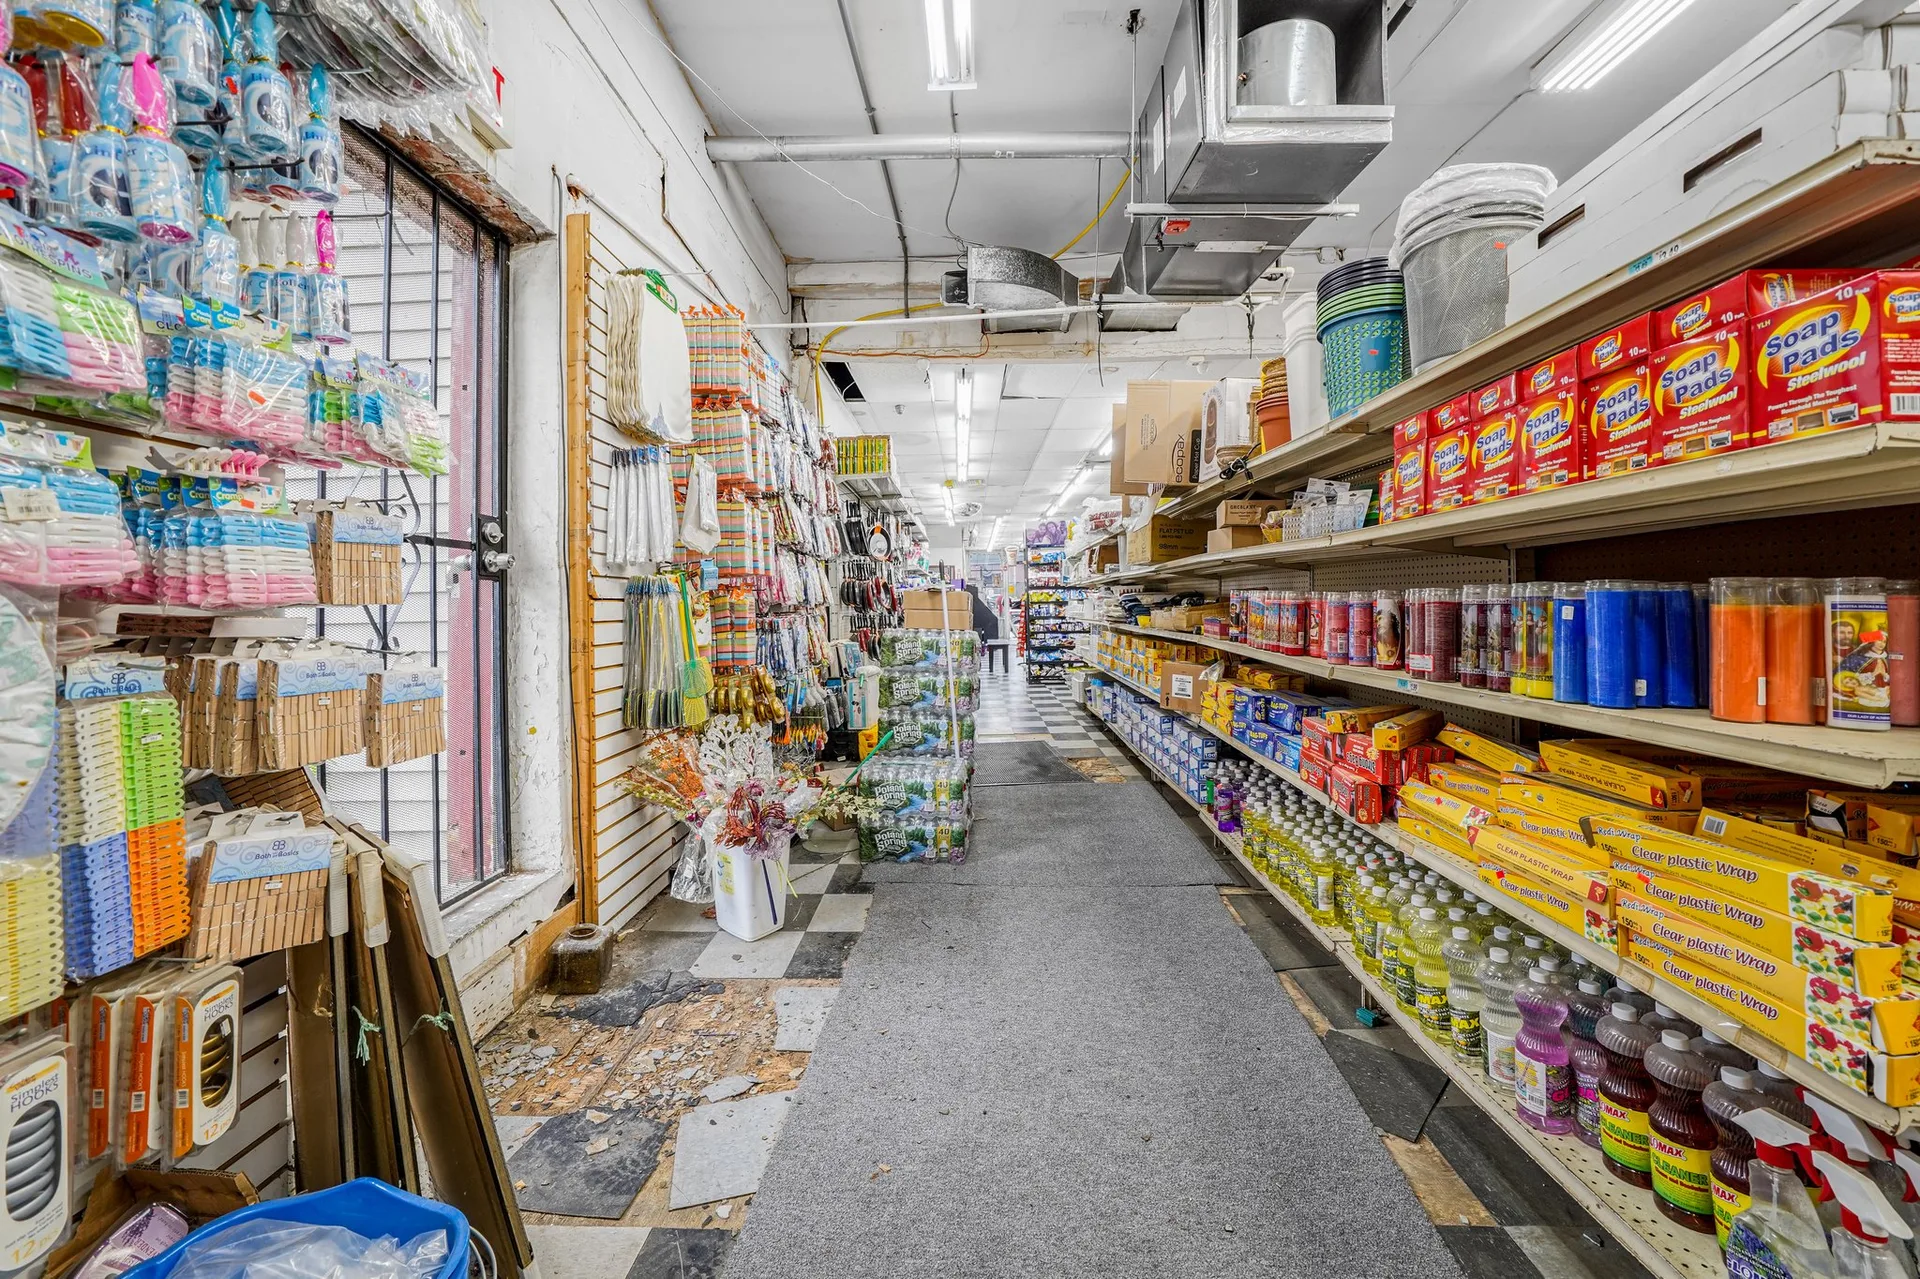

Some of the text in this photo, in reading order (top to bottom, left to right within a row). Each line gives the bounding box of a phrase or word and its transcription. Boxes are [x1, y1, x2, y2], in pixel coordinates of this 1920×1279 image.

[1834, 286, 1853, 301] 10
[216, 313, 246, 330] Cramp
[1674, 302, 1703, 325] Soap
[1681, 310, 1709, 332] Pads
[1719, 311, 1733, 324] 10
[1682, 319, 1713, 341] Steelwool
[1756, 318, 1771, 330] YLH
[1713, 329, 1727, 343] 10
[1765, 310, 1841, 358] Soap
[1628, 345, 1639, 358] 10
[1653, 355, 1666, 365] YLH
[1781, 328, 1861, 375] Pads
[1635, 364, 1647, 377] 10
[1660, 350, 1718, 390] Soap
[1786, 350, 1868, 393] Steelwool
[1560, 375, 1569, 386] 10
[1674, 366, 1734, 406] Pads
[1557, 390, 1567, 400] 10
[1595, 382, 1639, 416] Soap
[1678, 385, 1739, 420] Steelwool
[1767, 384, 1858, 412] Powers Through The Toughest
[1606, 398, 1650, 430] Pads
[1781, 403, 1811, 415] Household
[1524, 406, 1561, 434] Soap
[1608, 414, 1652, 443] Steelwool
[1708, 413, 1732, 425] Toughest
[1475, 426, 1507, 450] Soap
[1532, 419, 1570, 447] Pads
[1433, 442, 1459, 463] Soap
[1482, 437, 1513, 462] Pads
[1534, 434, 1573, 459] Steelwool
[1175, 433, 1186, 484] ecopax
[1397, 456, 1419, 475] Soap
[1439, 453, 1466, 474] Pads
[1402, 466, 1422, 483] Pads
[215, 491, 245, 504] Cramp
[1159, 527, 1173, 535] FLAT
[1173, 527, 1185, 535] PET
[1158, 542, 1179, 551] 98mm
[894, 640, 921, 653] Poland
[895, 647, 923, 661] Spring
[892, 679, 919, 693] Poland
[893, 687, 920, 700] Spring
[893, 722, 922, 735] Poland
[893, 730, 922, 743] Spring
[937, 780, 949, 789] 40
[1577, 770, 1606, 788] PLASTIC
[1606, 780, 1628, 793] CLEAR
[874, 783, 906, 797] Poland
[874, 830, 907, 845] Poland
[938, 828, 951, 836] 40
[1520, 820, 1567, 839] Clear plastic
[1596, 825, 1642, 843] Redi Wrap
[876, 838, 909, 853] Spring
[1601, 842, 1614, 855] 150
[1876, 836, 1888, 847] 150
[254, 849, 300, 861] Bath Basics
[1496, 842, 1519, 858] CLEAR
[1519, 852, 1550, 873] PLASTIC
[1550, 866, 1575, 883] WRAP
[1631, 844, 1759, 883] Clear plastic Wrap
[1613, 860, 1632, 872] Redi
[1615, 877, 1628, 890] 150
[1499, 877, 1570, 912] Clear plastic Wrap
[1621, 898, 1665, 921] Redi Wrap
[1644, 881, 1677, 902] Clear
[1678, 893, 1724, 915] plastic
[1724, 902, 1765, 930] Wrap
[1621, 916, 1634, 930] 150
[1633, 933, 1676, 959] Redi Wrap
[1651, 921, 1685, 945] Clear
[1686, 935, 1733, 963] plastic
[1734, 948, 1778, 978] Wrap
[1634, 951, 1646, 965] 150
[1662, 959, 1694, 984] Clear
[1694, 974, 1739, 1002] plastic
[1738, 989, 1779, 1021] Wrap
[203, 993, 235, 1014] Simplest
[203, 1000, 234, 1023] HOOKS
[11, 1073, 60, 1103] Simplest
[10, 1082, 60, 1114] HOOKS
[202, 1122, 220, 1141] 12
[1601, 1115, 1650, 1146] CLEANER
[1652, 1151, 1709, 1187] CLEANER
[10, 1240, 38, 1265] 12
